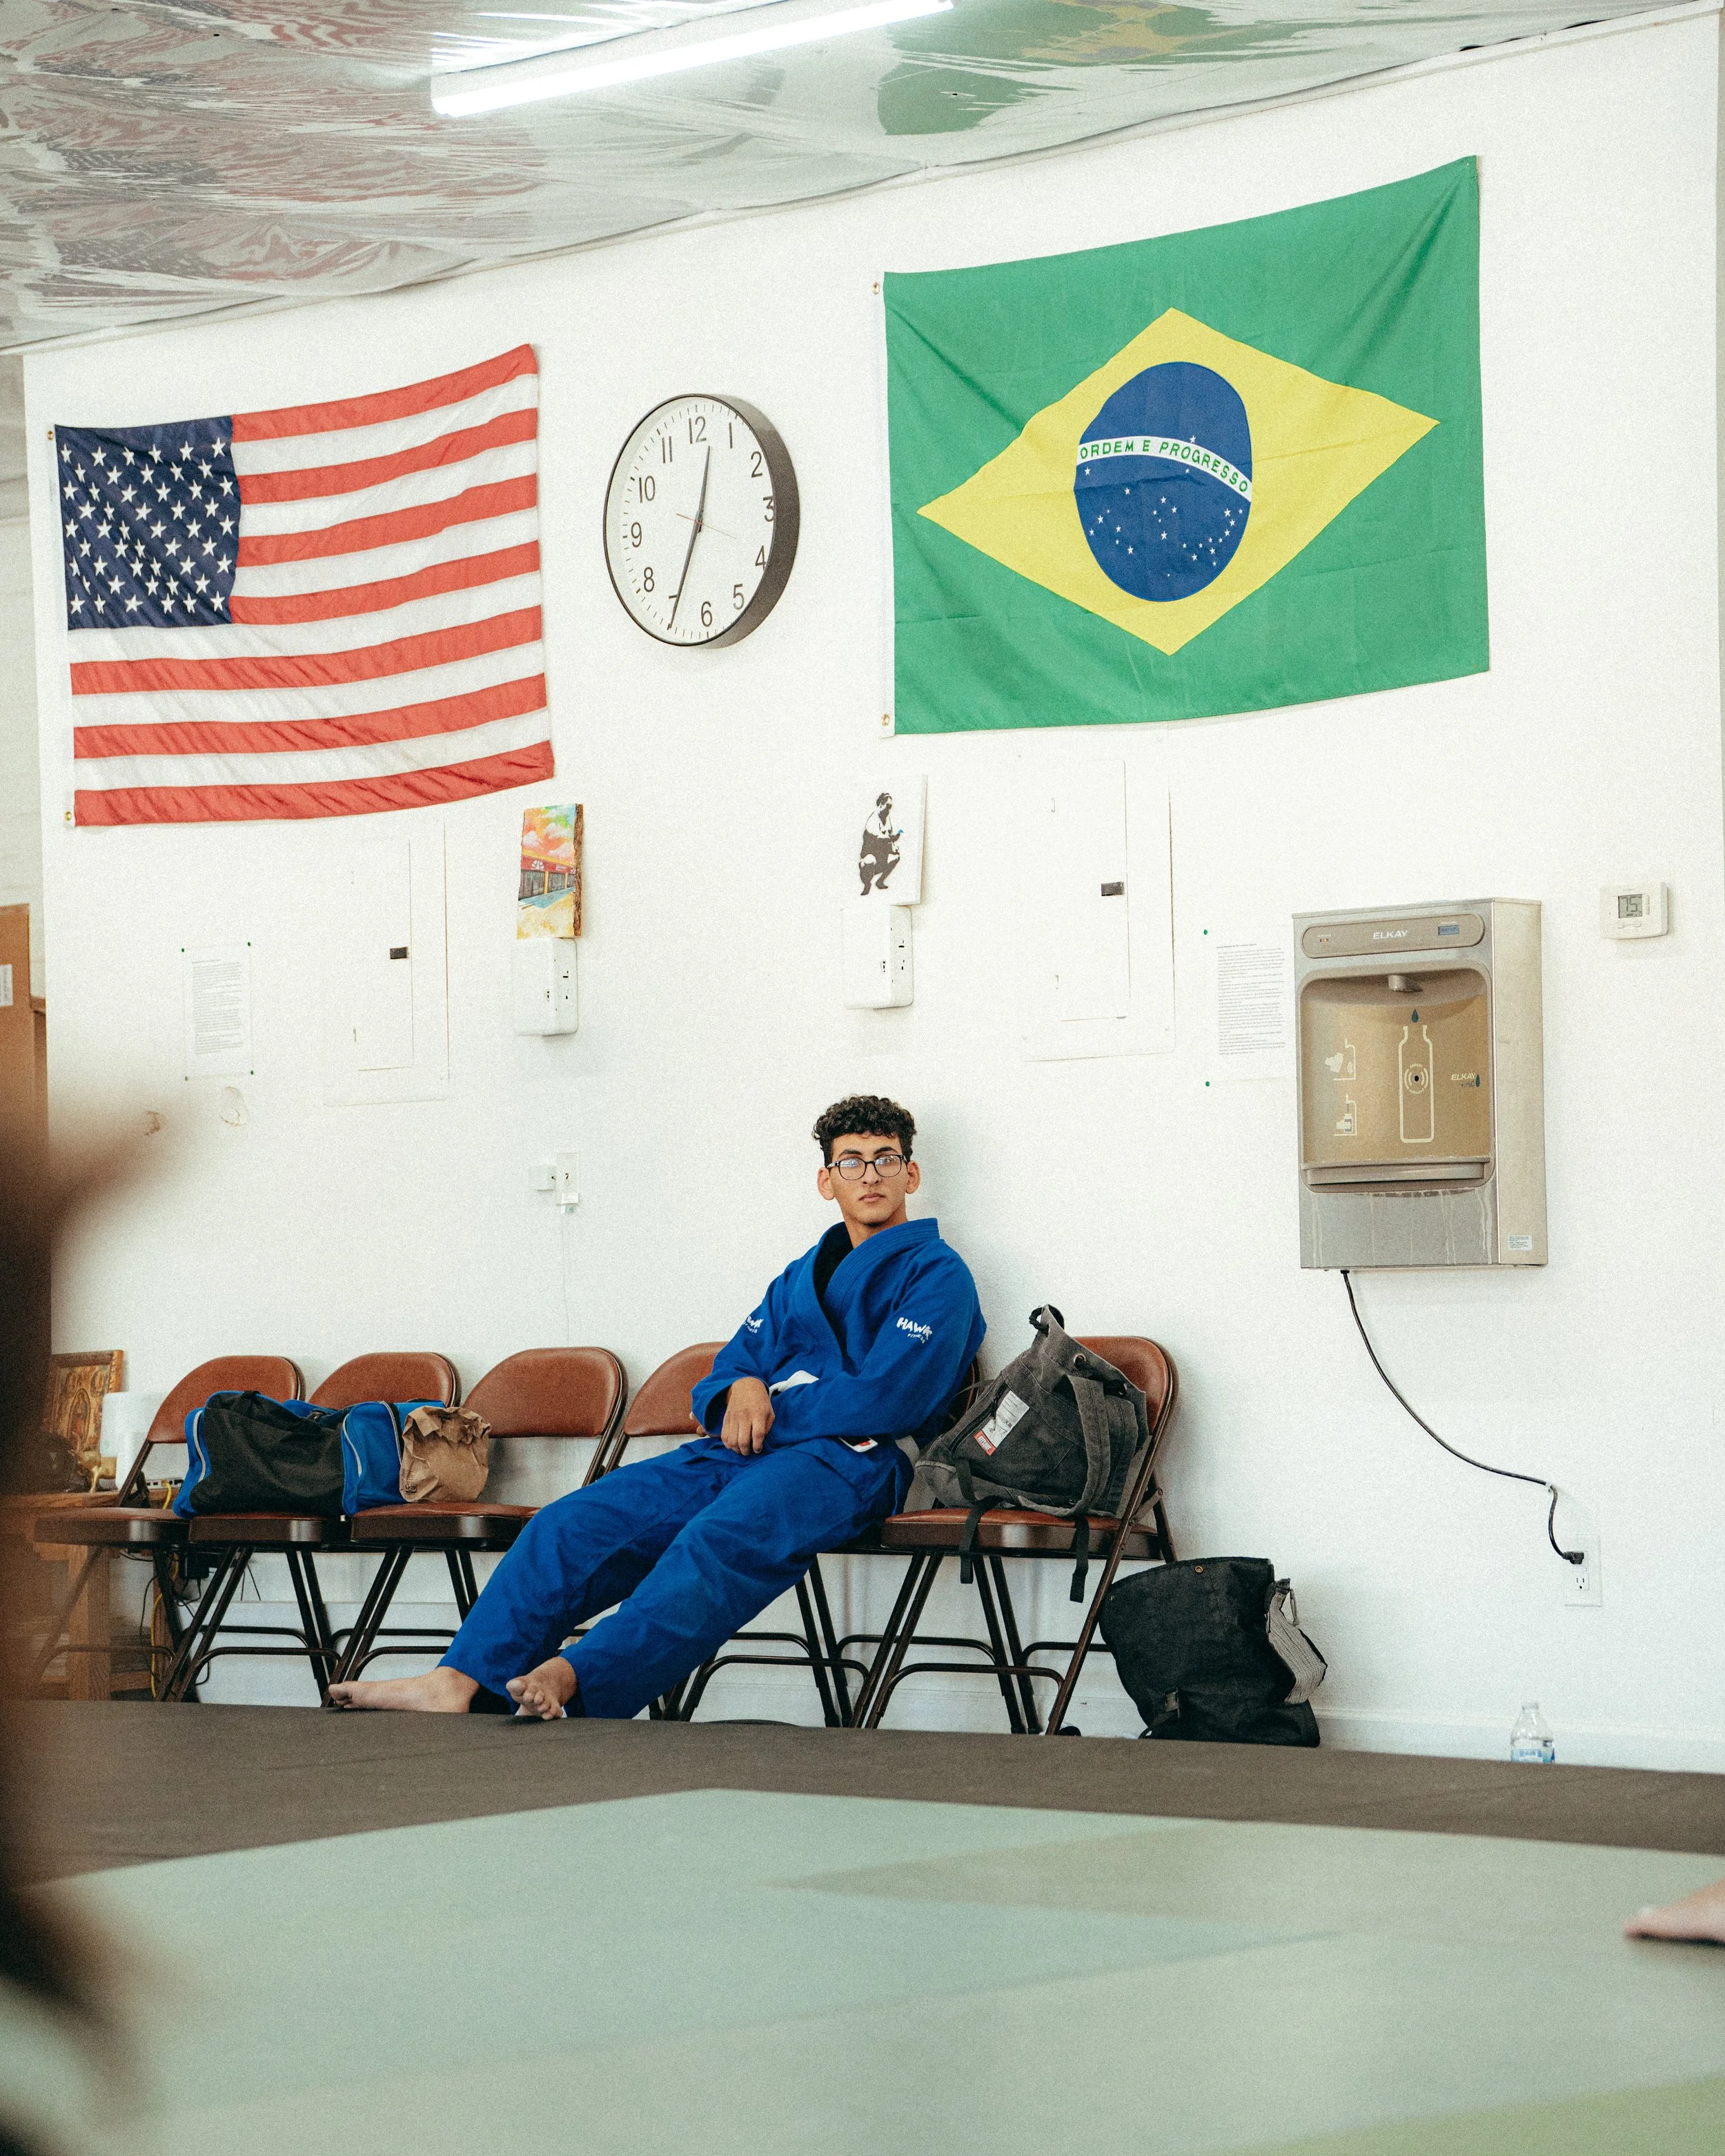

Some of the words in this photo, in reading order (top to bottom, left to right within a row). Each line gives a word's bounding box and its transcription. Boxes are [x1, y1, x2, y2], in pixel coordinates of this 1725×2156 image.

[689, 415, 707, 444] 12
[729, 422, 733, 448] 1
[662, 435, 673, 464] 11
[751, 451, 763, 478] 2
[1080, 439, 1134, 459] ORDEM
[1142, 439, 1152, 453] E
[1159, 441, 1248, 493] PROGRESSO
[639, 475, 656, 504] 10
[762, 495, 775, 523] 3
[630, 522, 642, 548] 9
[755, 545, 767, 571] 4
[643, 566, 655, 593] 8
[733, 583, 745, 610] 5
[700, 601, 713, 627] 6
[1372, 930, 1409, 940] ELKAY
[1451, 1073, 1476, 1081] ELKAY
